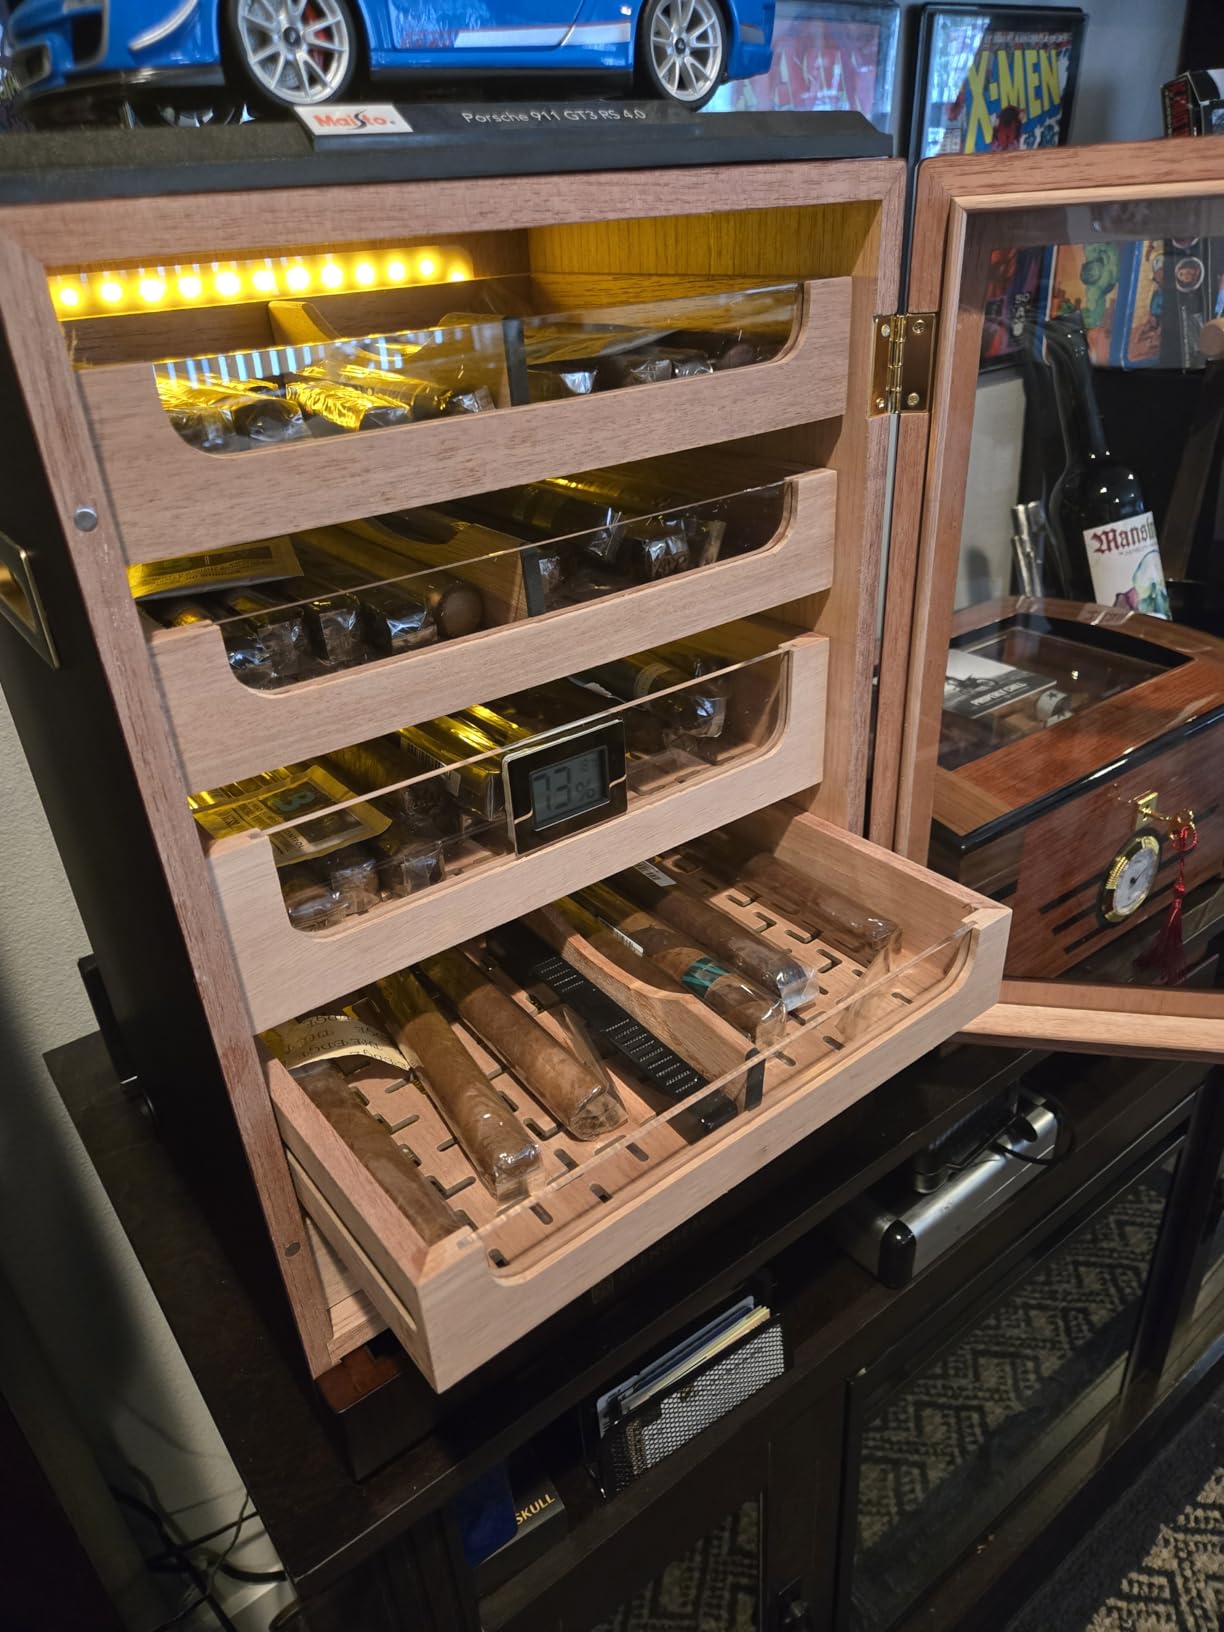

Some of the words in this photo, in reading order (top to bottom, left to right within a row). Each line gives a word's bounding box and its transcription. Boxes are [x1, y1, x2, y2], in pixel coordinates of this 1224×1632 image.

[964, 49, 1061, 155] X-MEN
[313, 108, 387, 129] Maisto
[461, 111, 529, 124] Porsche
[529, 110, 561, 121] 911
[563, 109, 598, 121] GT3
[598, 109, 620, 120] RS
[623, 108, 647, 120] 4.0
[515, 1493, 556, 1525] SKULL
